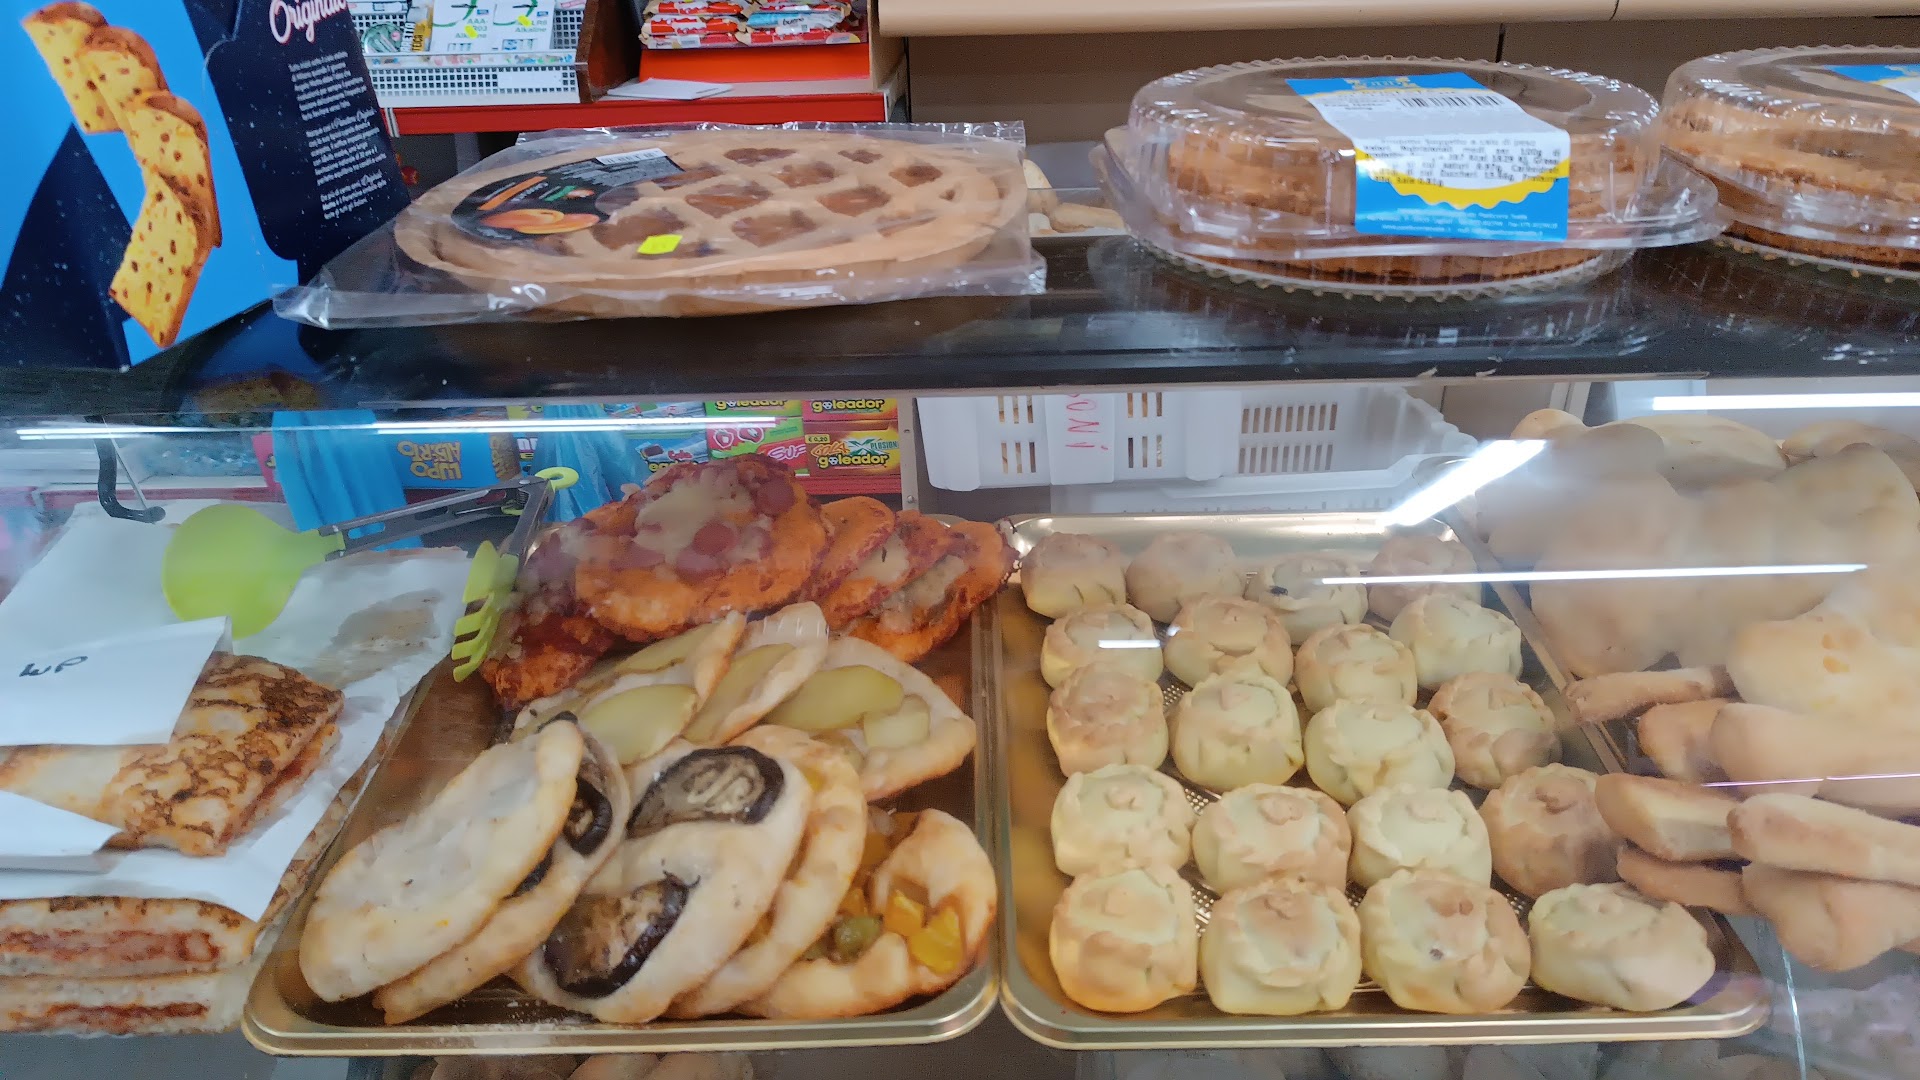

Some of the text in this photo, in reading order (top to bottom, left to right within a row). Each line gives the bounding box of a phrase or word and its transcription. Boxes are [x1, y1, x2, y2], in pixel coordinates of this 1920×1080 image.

[812, 398, 885, 413] goleador
[818, 453, 890, 469] goleador
[410, 461, 462, 481] LUPO
